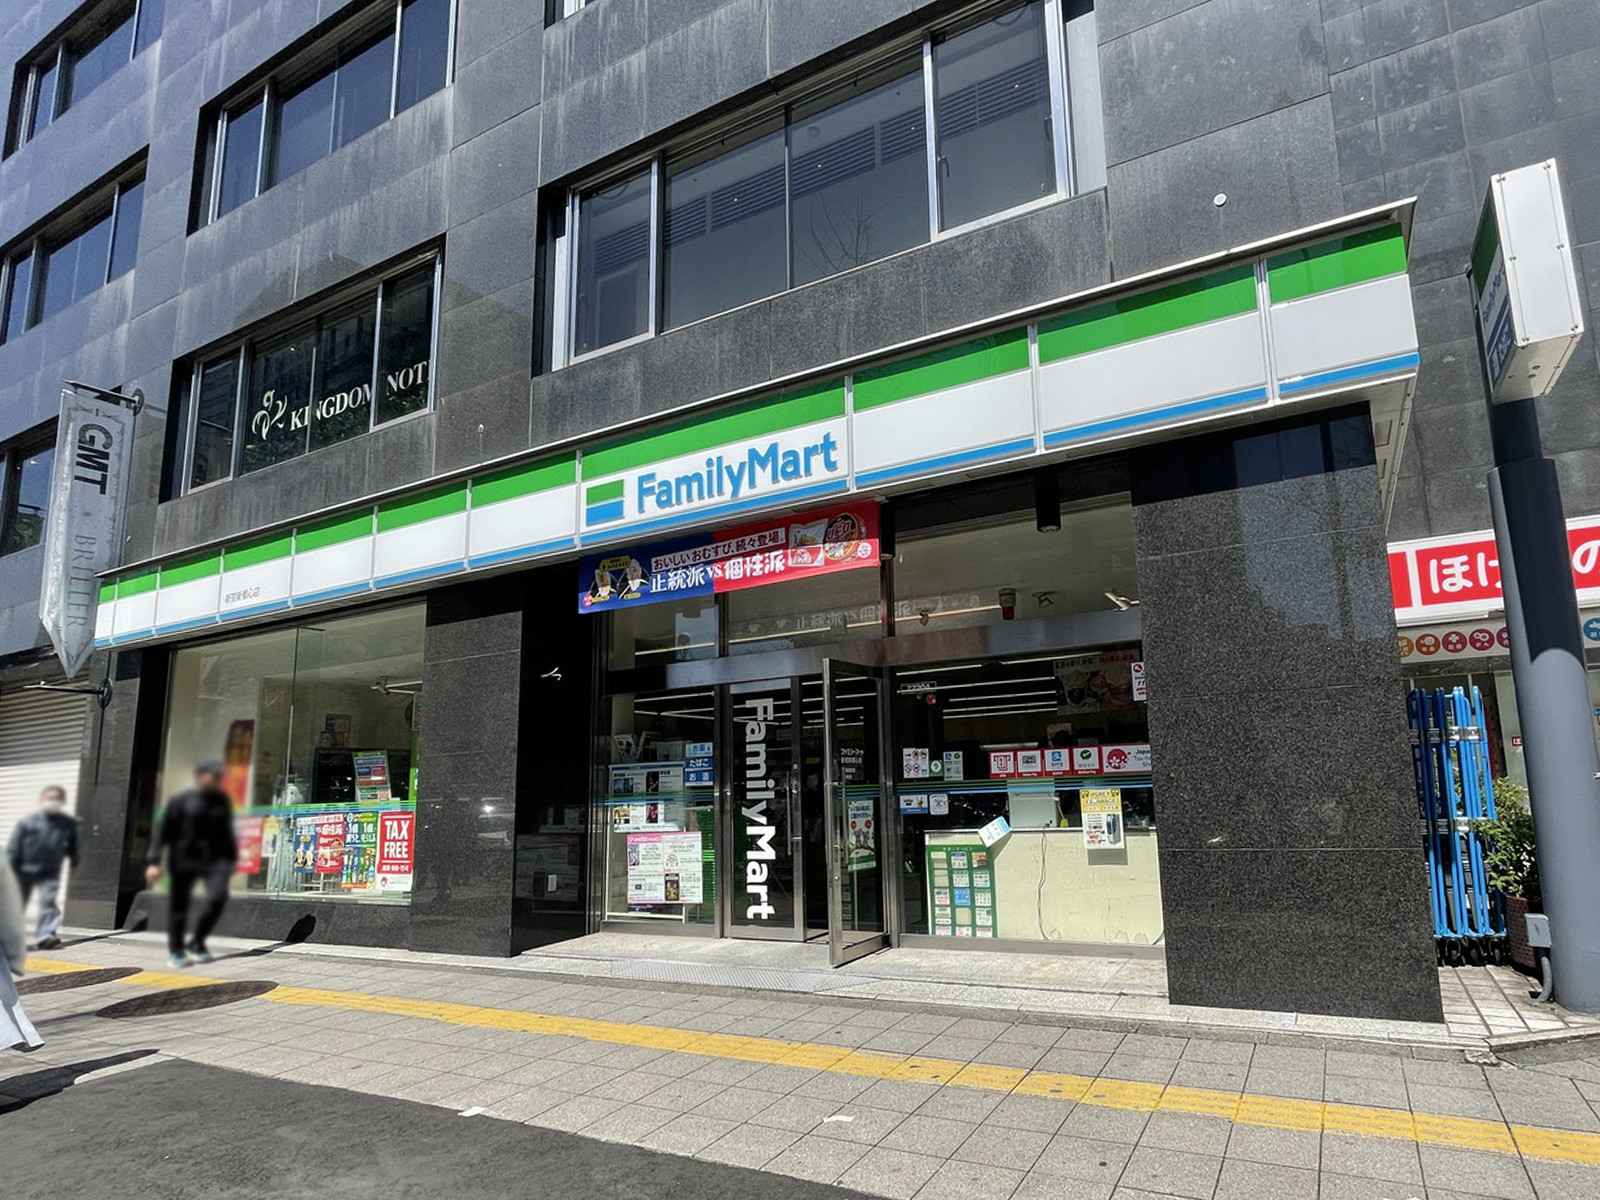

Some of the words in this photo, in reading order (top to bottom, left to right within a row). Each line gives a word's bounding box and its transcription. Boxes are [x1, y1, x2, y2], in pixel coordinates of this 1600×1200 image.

[386, 361, 429, 395] NOT
[74, 423, 113, 495] GMT
[637, 432, 838, 514] FamilyMart
[385, 820, 410, 840] TAX
[741, 697, 776, 920] FamilyMart
[384, 841, 409, 859] FREE
